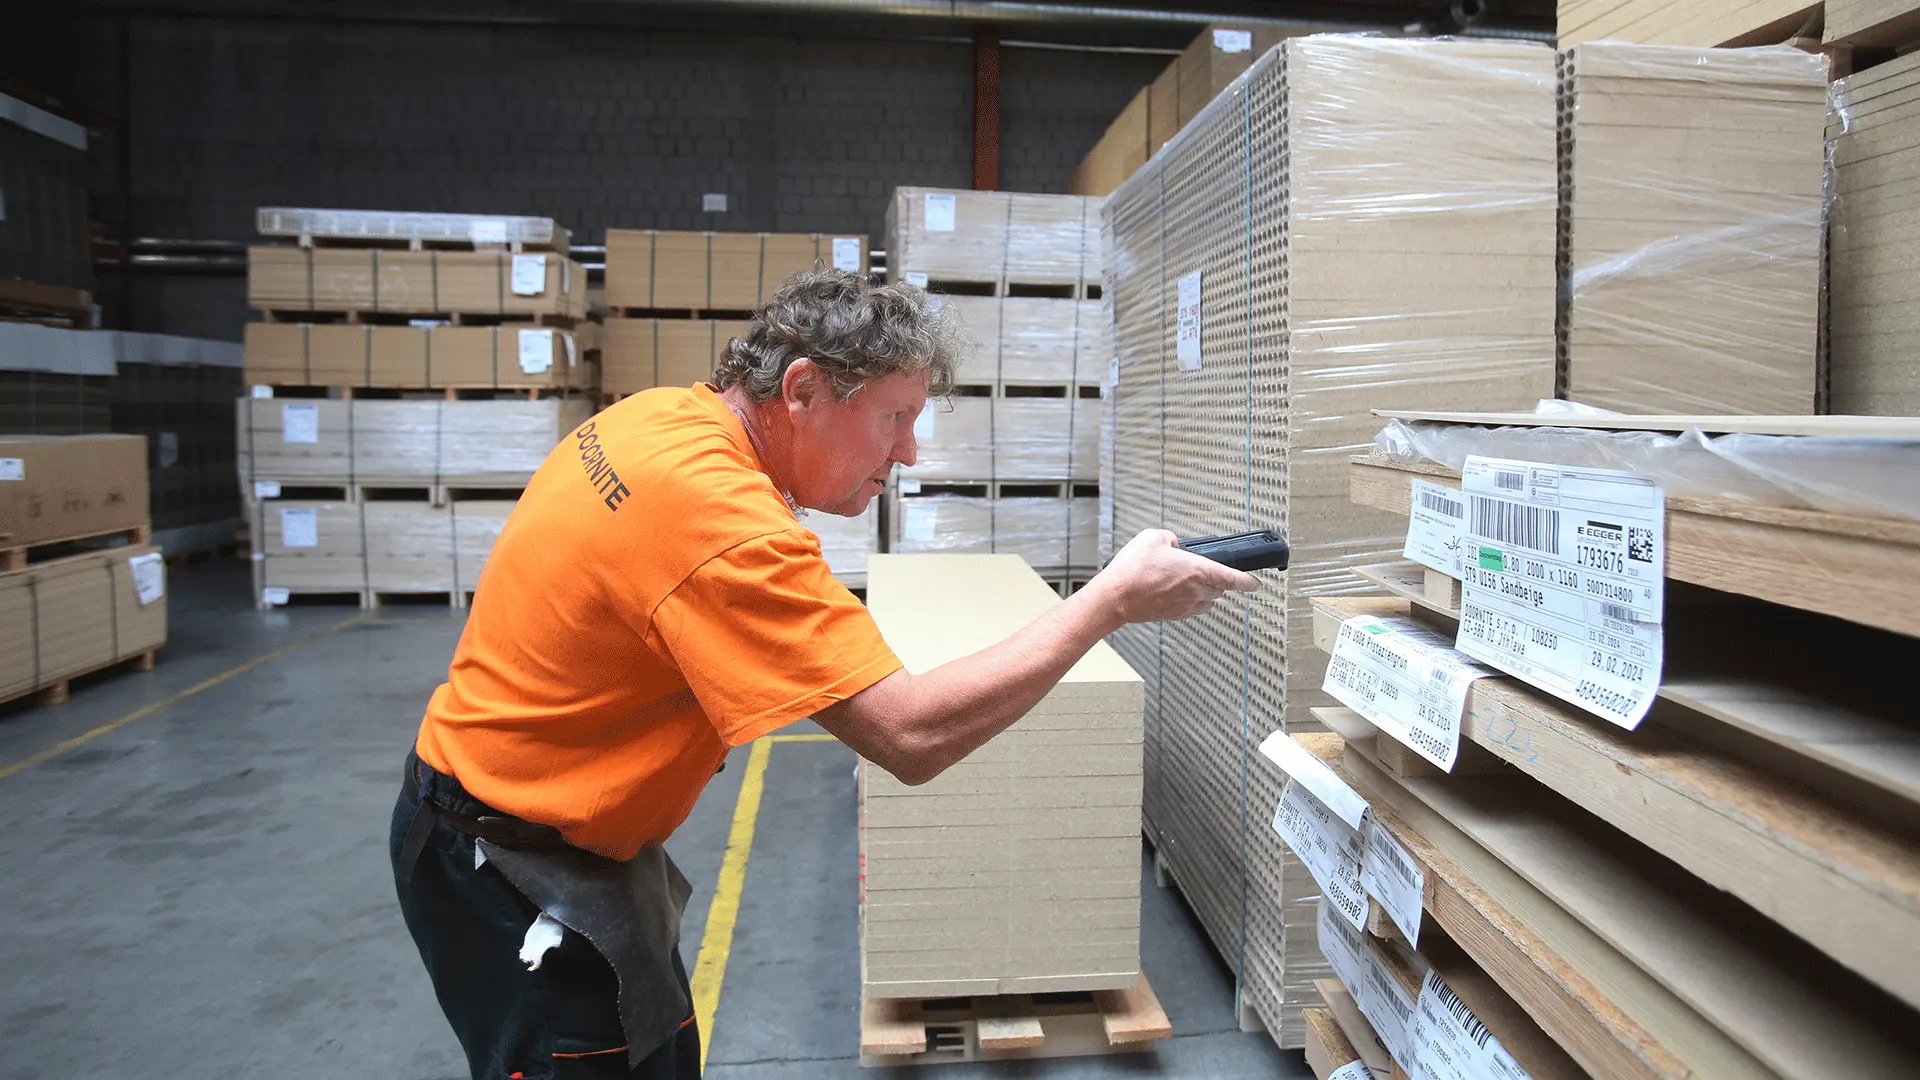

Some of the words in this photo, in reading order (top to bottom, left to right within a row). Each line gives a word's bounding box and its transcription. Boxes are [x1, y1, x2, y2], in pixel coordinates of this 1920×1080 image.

[577, 422, 631, 512] DOORNITE
[1587, 527, 1622, 542] EGGER
[1577, 544, 1624, 574] 1793676
[1464, 565, 1476, 584] ST9
[1479, 569, 1497, 590] U156
[1501, 576, 1544, 608] Sandbeige
[1526, 560, 1544, 580] 2000
[1559, 568, 1578, 589] 1160
[1586, 578, 1633, 604] 5007314800
[1464, 603, 1494, 627] DOORNITE
[1496, 618, 1519, 636] s.r.o.
[1531, 627, 1558, 651] 108250
[1498, 632, 1526, 656] Jihlava
[1591, 650, 1644, 682] 29.02.2024
[1574, 679, 1637, 718] 4684560202
[1418, 703, 1452, 731] 29.02.2024
